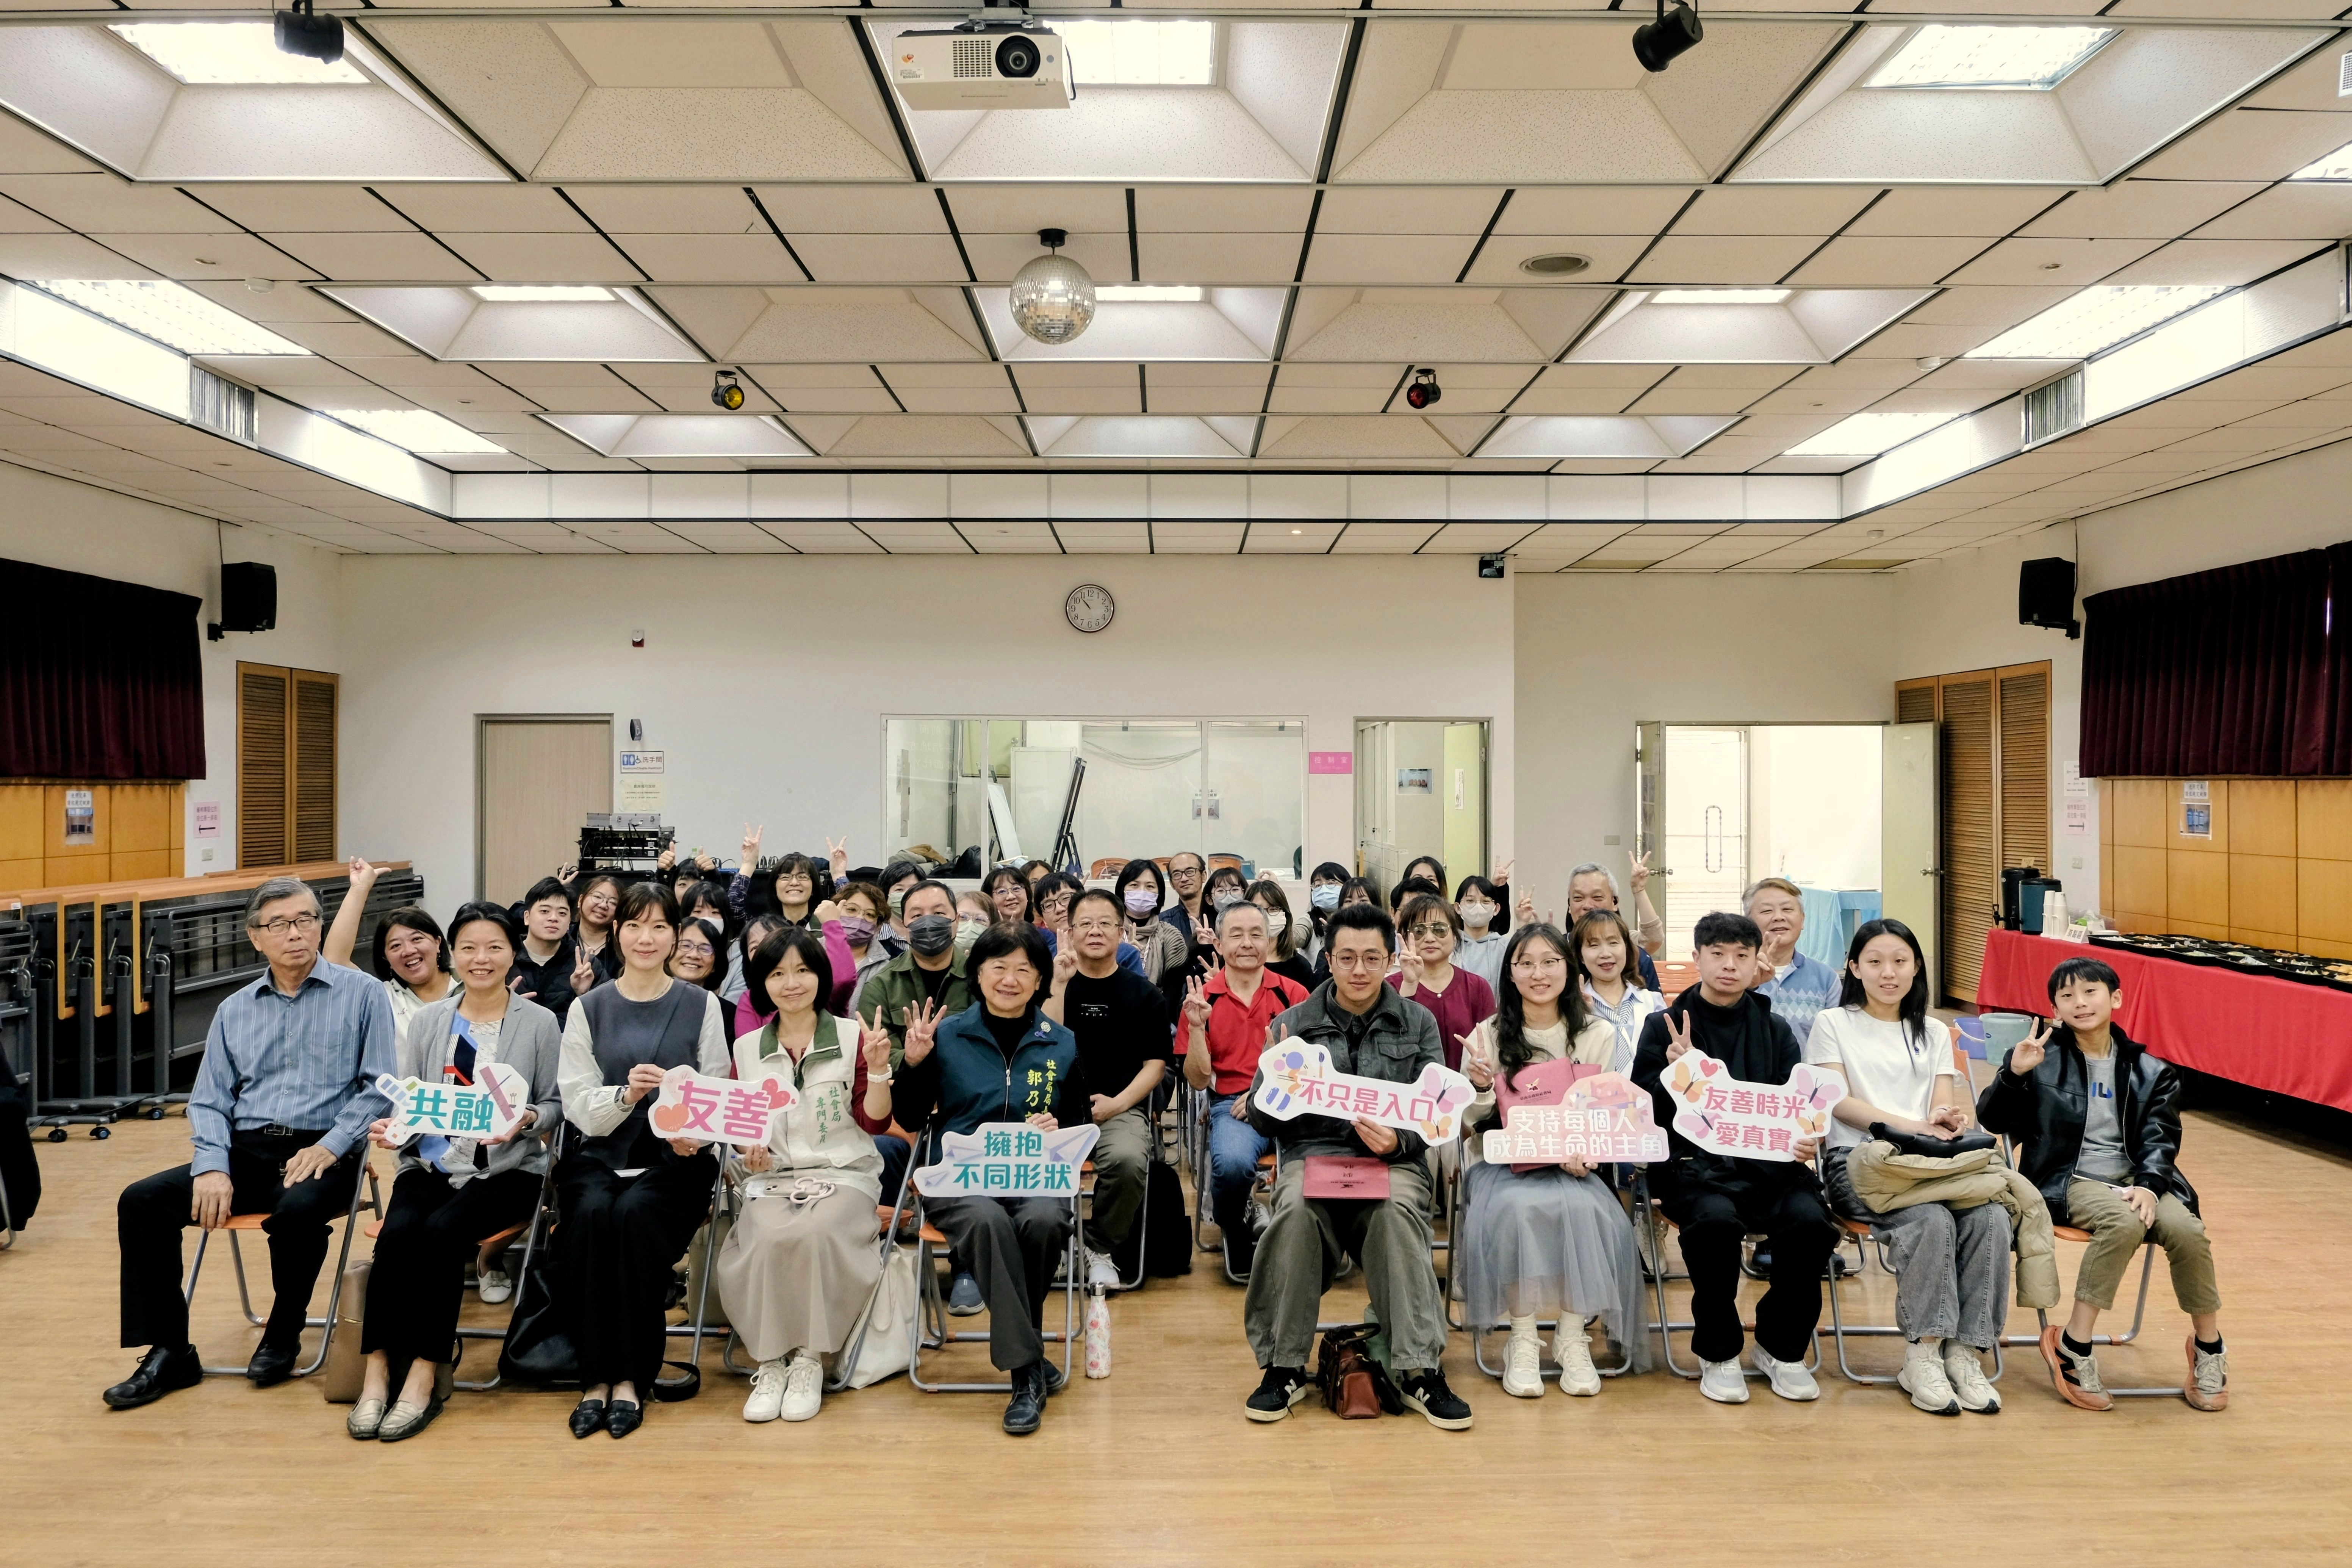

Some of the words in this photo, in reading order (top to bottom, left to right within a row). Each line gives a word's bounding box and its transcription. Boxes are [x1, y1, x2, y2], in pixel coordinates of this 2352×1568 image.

[406, 1088, 494, 1133] 共融
[682, 1081, 770, 1140] 友善
[829, 1086, 841, 1122] 社會局
[1299, 1078, 1434, 1122] 不只是入口
[1704, 1086, 1806, 1119] 友善時光
[815, 1097, 828, 1145] 專門委員
[1513, 1109, 1637, 1133] 支持每個人
[1716, 1122, 1792, 1152] 愛真實
[984, 1130, 1042, 1157] 擁抱
[1490, 1133, 1663, 1158] 成為生命的主角
[953, 1163, 1072, 1189] 不同形狀
